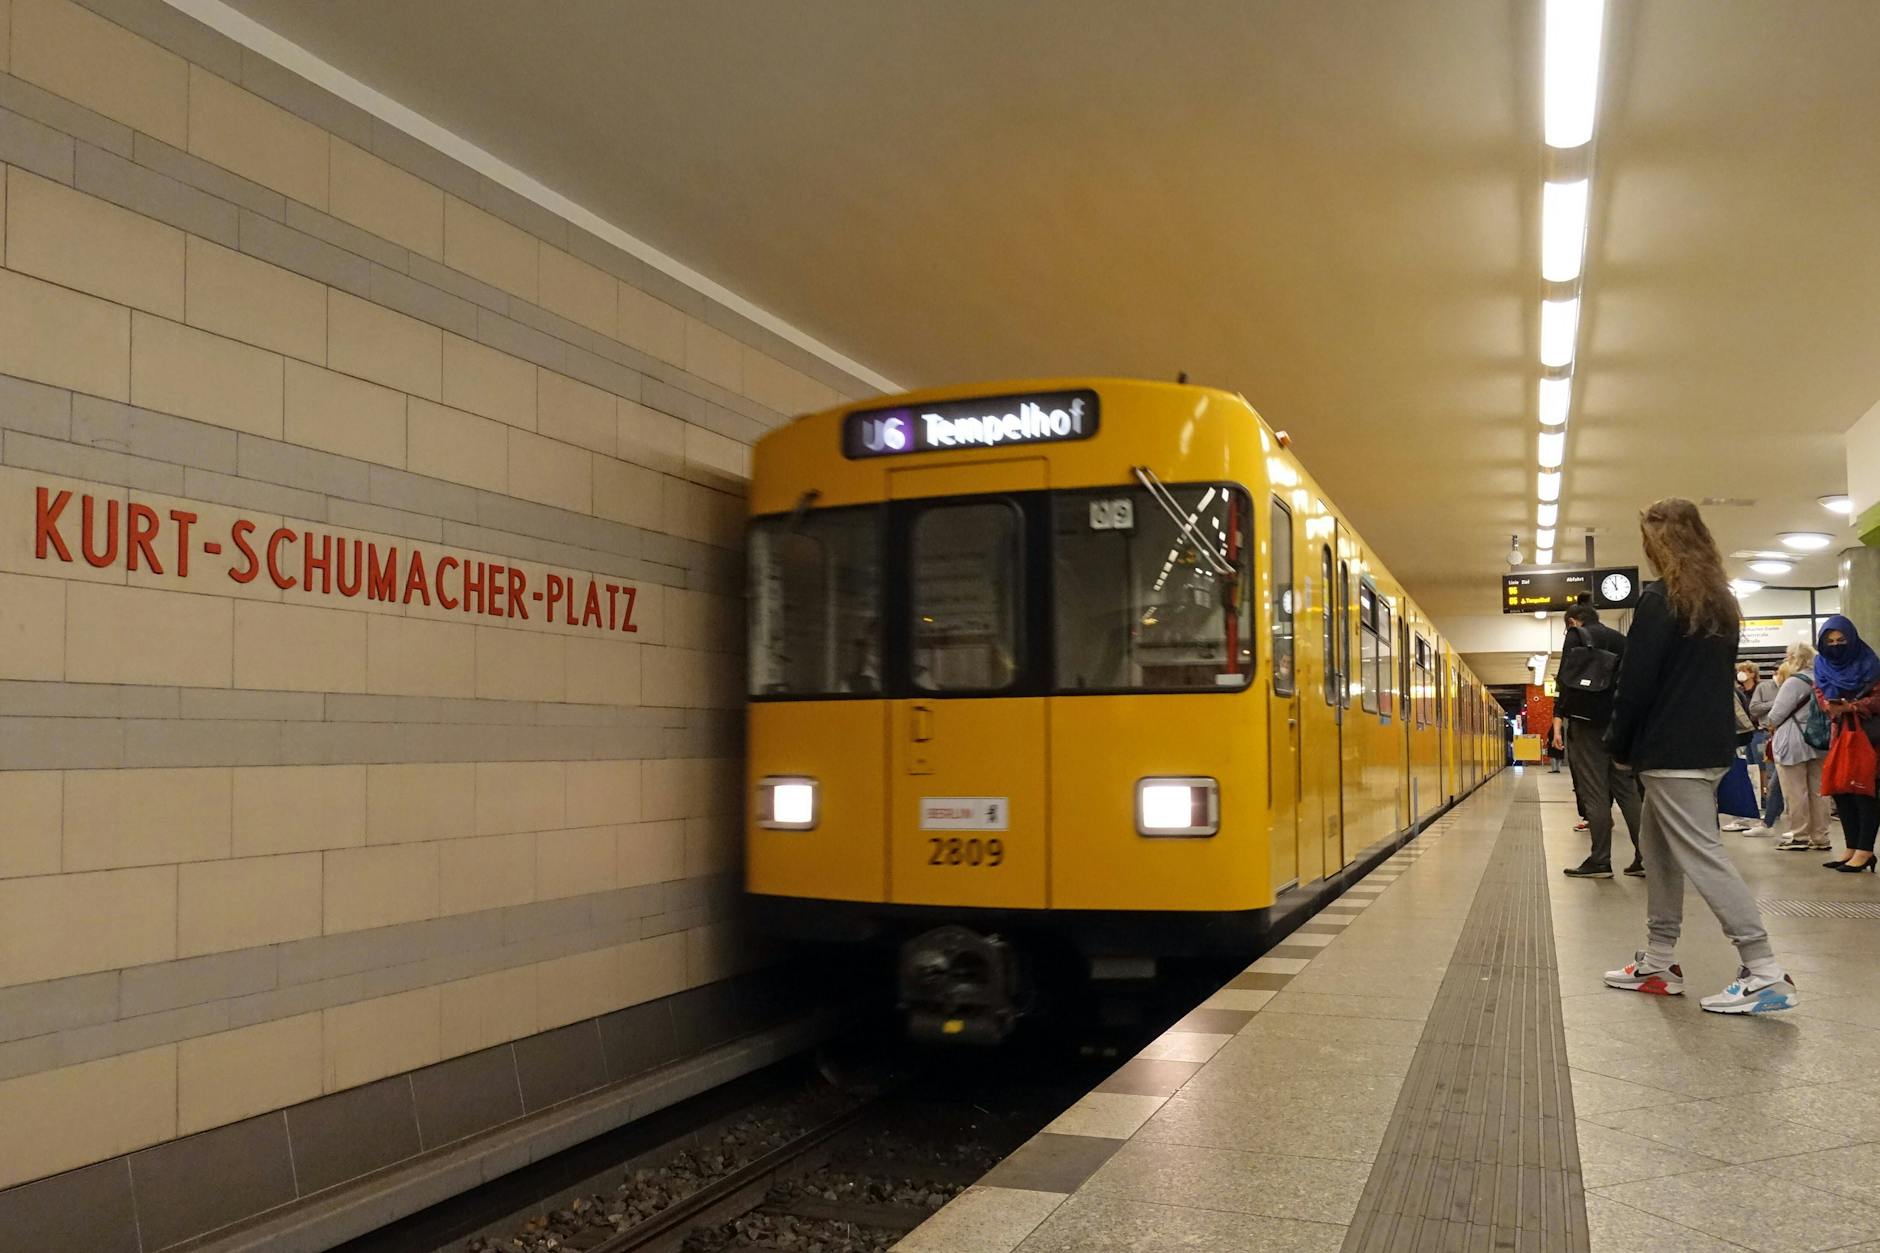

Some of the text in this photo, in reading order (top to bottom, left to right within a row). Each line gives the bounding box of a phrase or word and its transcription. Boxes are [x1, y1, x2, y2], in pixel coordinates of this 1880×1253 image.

[862, 397, 1086, 451] U6 Tempelhof
[35, 486, 639, 634] KURT-SCHUMACHER-PLATZ
[927, 837, 1004, 867] 2809
